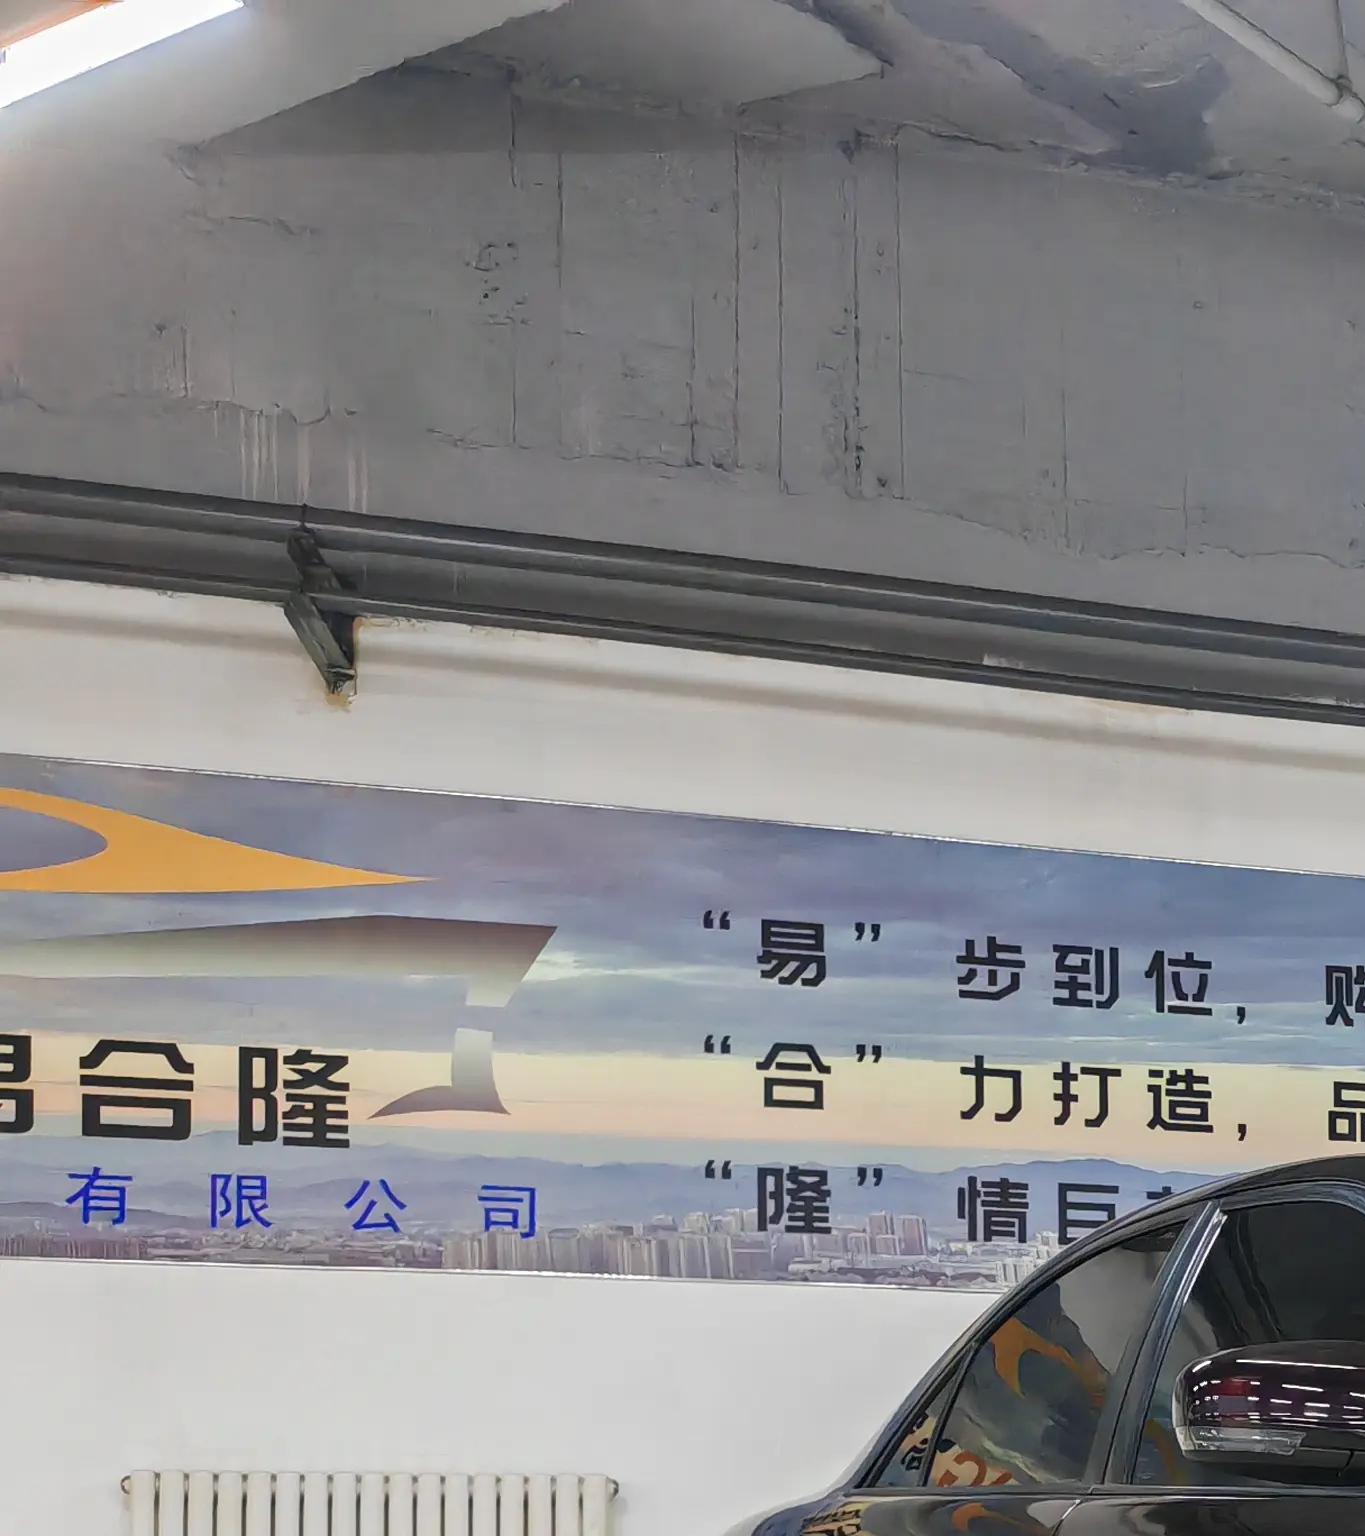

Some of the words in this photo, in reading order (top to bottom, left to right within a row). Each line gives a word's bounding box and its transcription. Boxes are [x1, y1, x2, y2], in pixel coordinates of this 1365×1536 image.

[65, 1166, 539, 1240] 有限公司
[705, 1159, 1174, 1245] “隆”情巨
